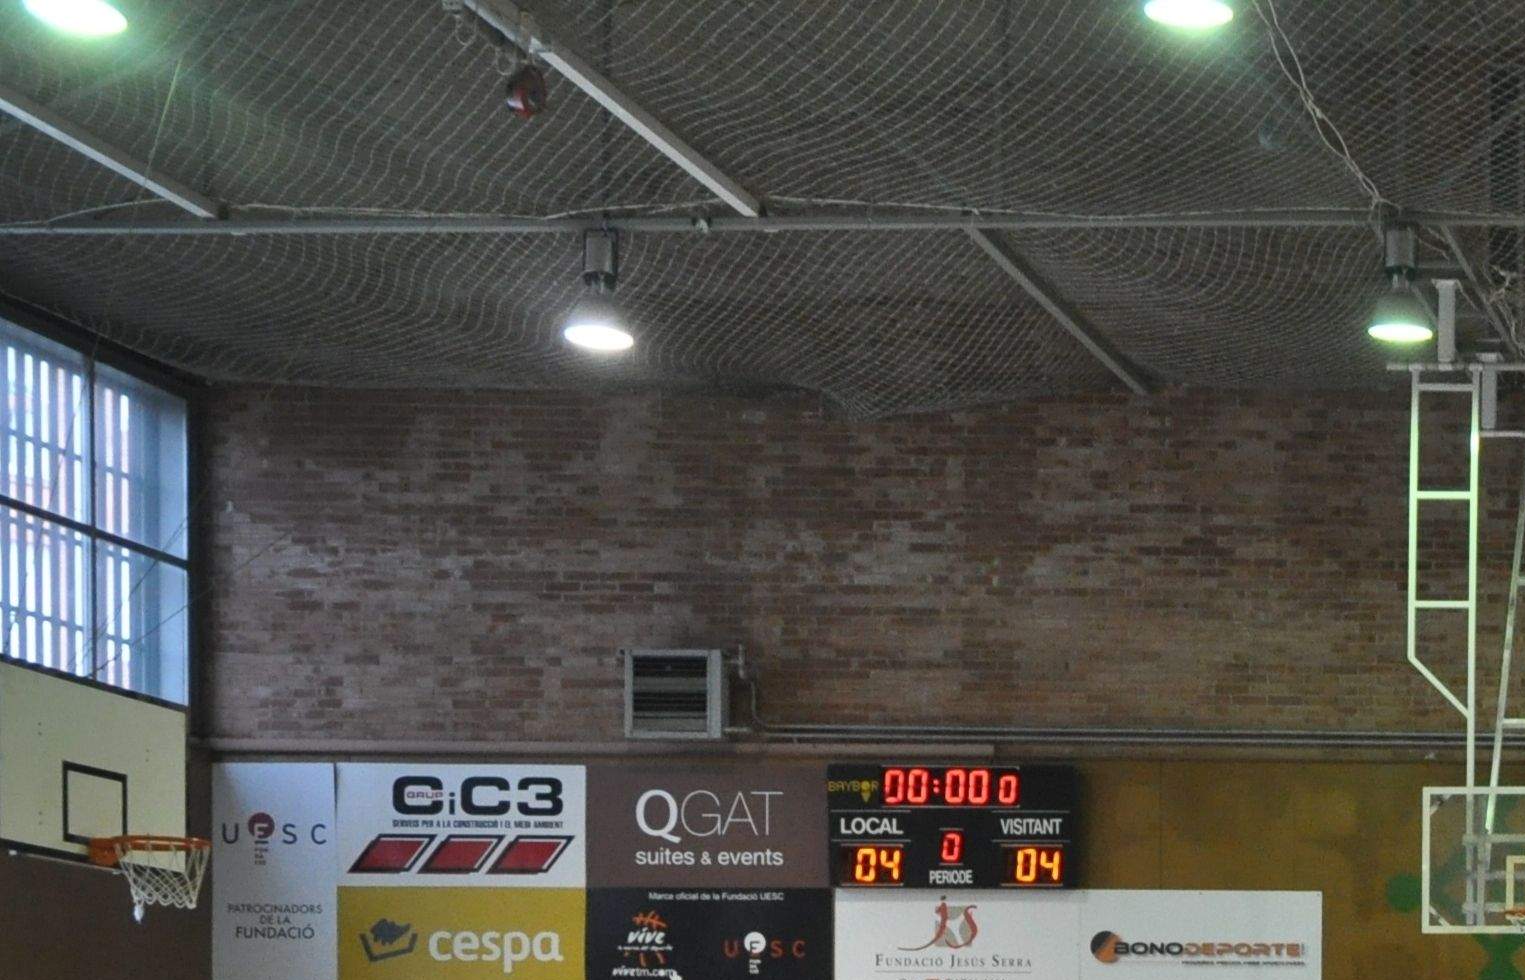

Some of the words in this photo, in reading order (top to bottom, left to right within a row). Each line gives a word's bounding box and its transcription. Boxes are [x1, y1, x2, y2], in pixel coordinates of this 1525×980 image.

[885, 769, 989, 803] 00:00
[635, 789, 784, 843] QGAT
[841, 817, 904, 834] LOCAL
[1000, 818, 1062, 834] VISITANT
[942, 833, 961, 861] 0
[635, 848, 695, 865] suites
[700, 851, 712, 865] &
[718, 849, 784, 865] events
[855, 848, 900, 882] 04
[1016, 848, 1060, 882] 04
[929, 870, 973, 884] PERIODE
[701, 892, 711, 900] de
[227, 904, 323, 914] PATROCINADORS
[260, 915, 274, 925] DE
[278, 916, 292, 925] LA
[235, 924, 315, 940] FUNDACIÓ
[428, 930, 564, 973] cespa
[991, 954, 1032, 968] SERRA
